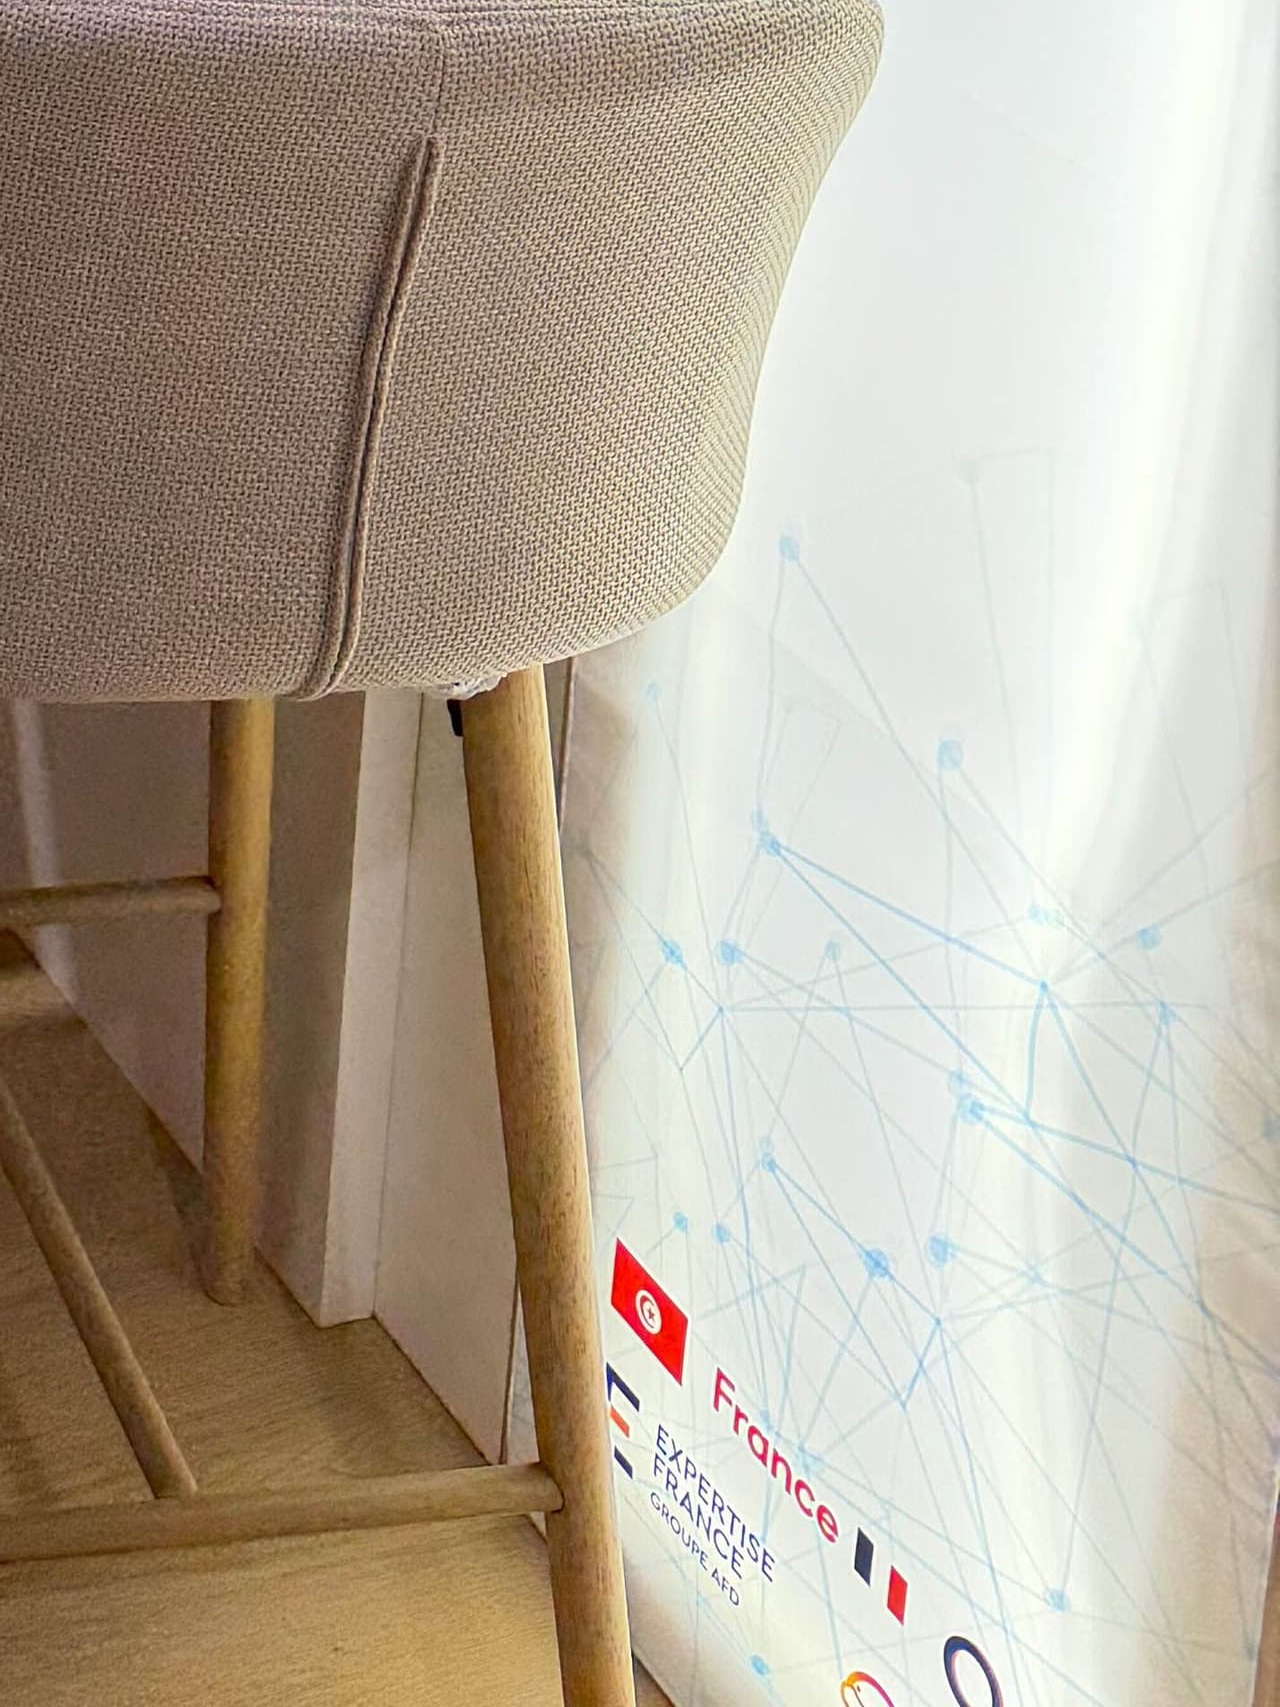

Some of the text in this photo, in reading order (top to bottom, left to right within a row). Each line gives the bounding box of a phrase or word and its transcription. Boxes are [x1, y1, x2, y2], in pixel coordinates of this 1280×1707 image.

[652, 1453, 745, 1580] FRANCE
[655, 1423, 777, 1583] EXPERTISE
[712, 1366, 839, 1544] France
[650, 1491, 741, 1607] GROUPE AFD
